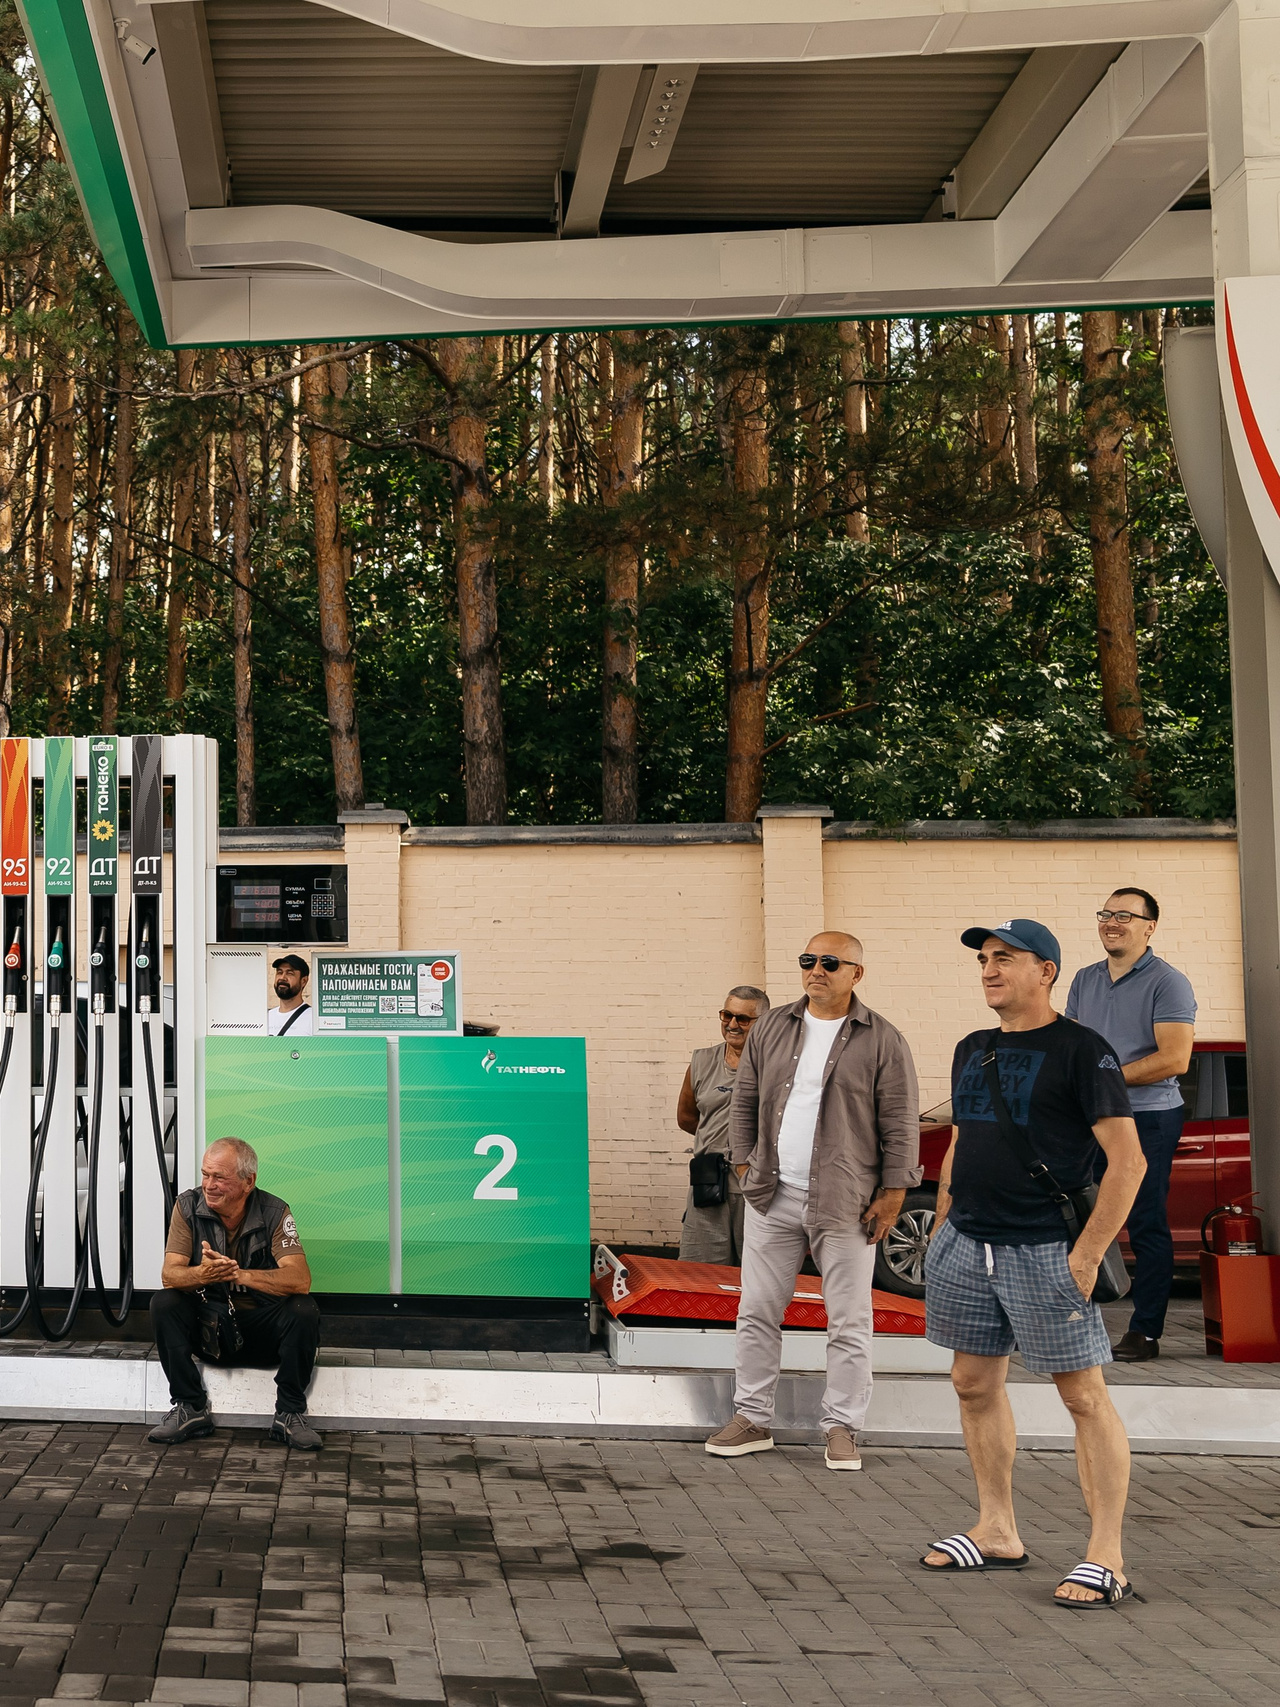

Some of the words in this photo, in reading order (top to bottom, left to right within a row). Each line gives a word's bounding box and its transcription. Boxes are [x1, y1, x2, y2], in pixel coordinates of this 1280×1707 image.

[3, 858, 26, 876] 95
[46, 857, 71, 876] 92
[90, 857, 117, 876] ДТ
[133, 856, 161, 874] ДТ
[321, 963, 381, 975] УВАЖАЕМЫЕ
[383, 963, 416, 976] ГОСТИ,
[322, 979, 387, 991] НАПОМИНАЕМ
[391, 979, 411, 991] ВАМ
[496, 1066, 566, 1074] ТАТНЕФТЬ
[958, 1074, 1028, 1094] RUBY
[473, 1133, 518, 1200] 2
